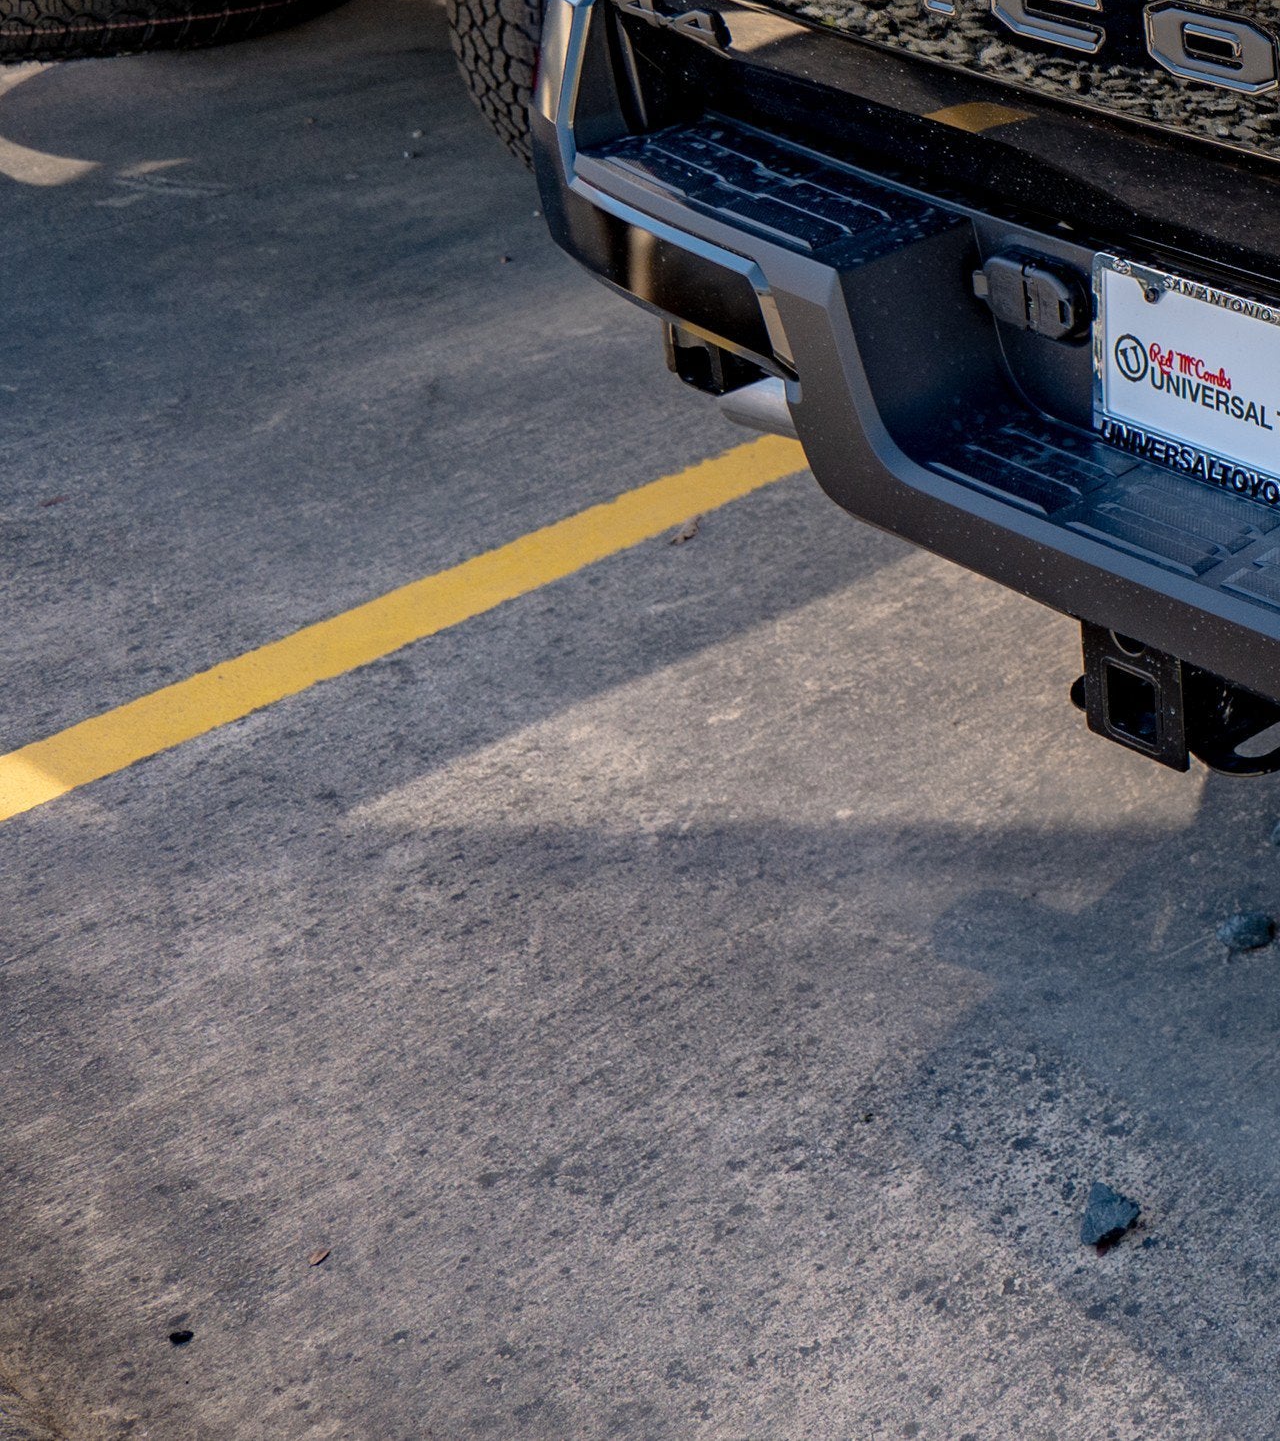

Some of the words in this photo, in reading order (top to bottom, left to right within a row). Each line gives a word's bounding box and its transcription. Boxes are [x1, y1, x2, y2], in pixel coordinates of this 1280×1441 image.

[1163, 274, 1196, 300] SAN
[1149, 343, 1174, 376] Red
[1175, 351, 1231, 390] McCombs
[1150, 366, 1273, 431] UNIVERSAL
